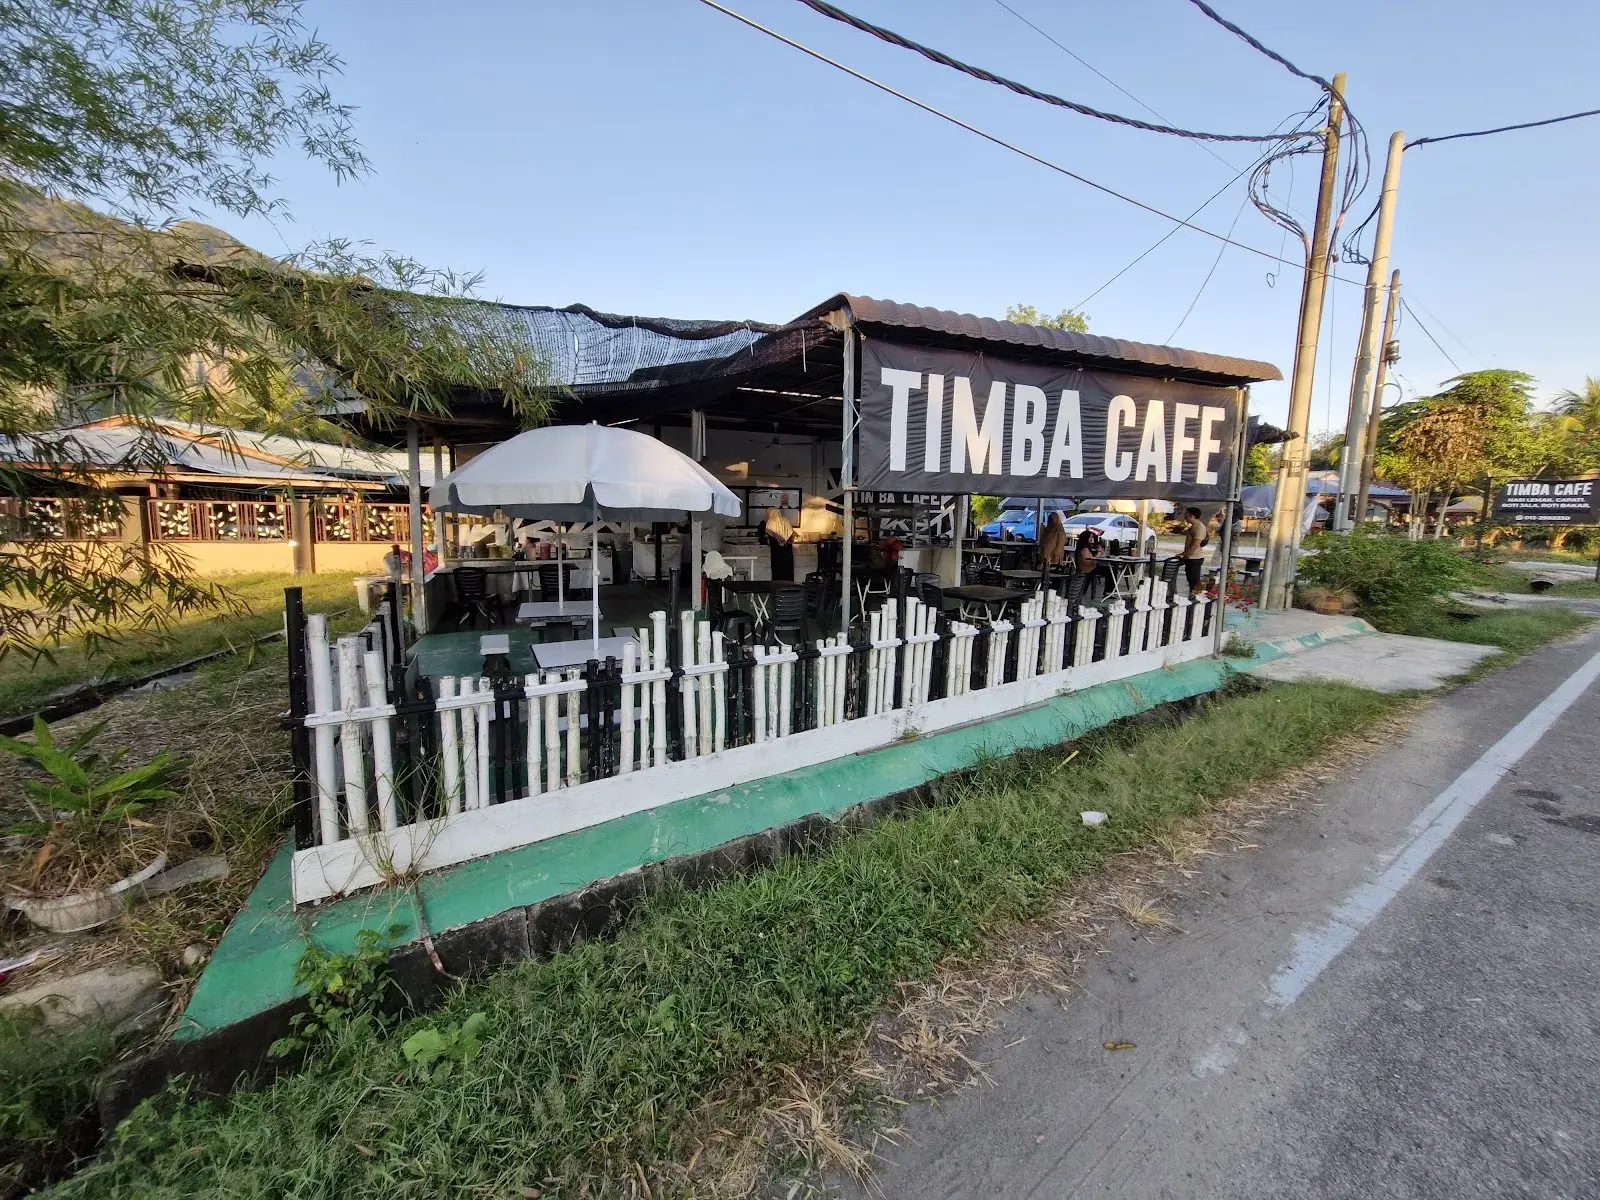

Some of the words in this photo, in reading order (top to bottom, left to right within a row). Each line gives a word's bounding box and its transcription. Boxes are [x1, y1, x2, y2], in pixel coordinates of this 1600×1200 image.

[881, 367, 1084, 479] TIMBA
[1104, 395, 1226, 485] CAFE
[1506, 483, 1550, 496] TIMBA
[1554, 482, 1594, 496] CAFE
